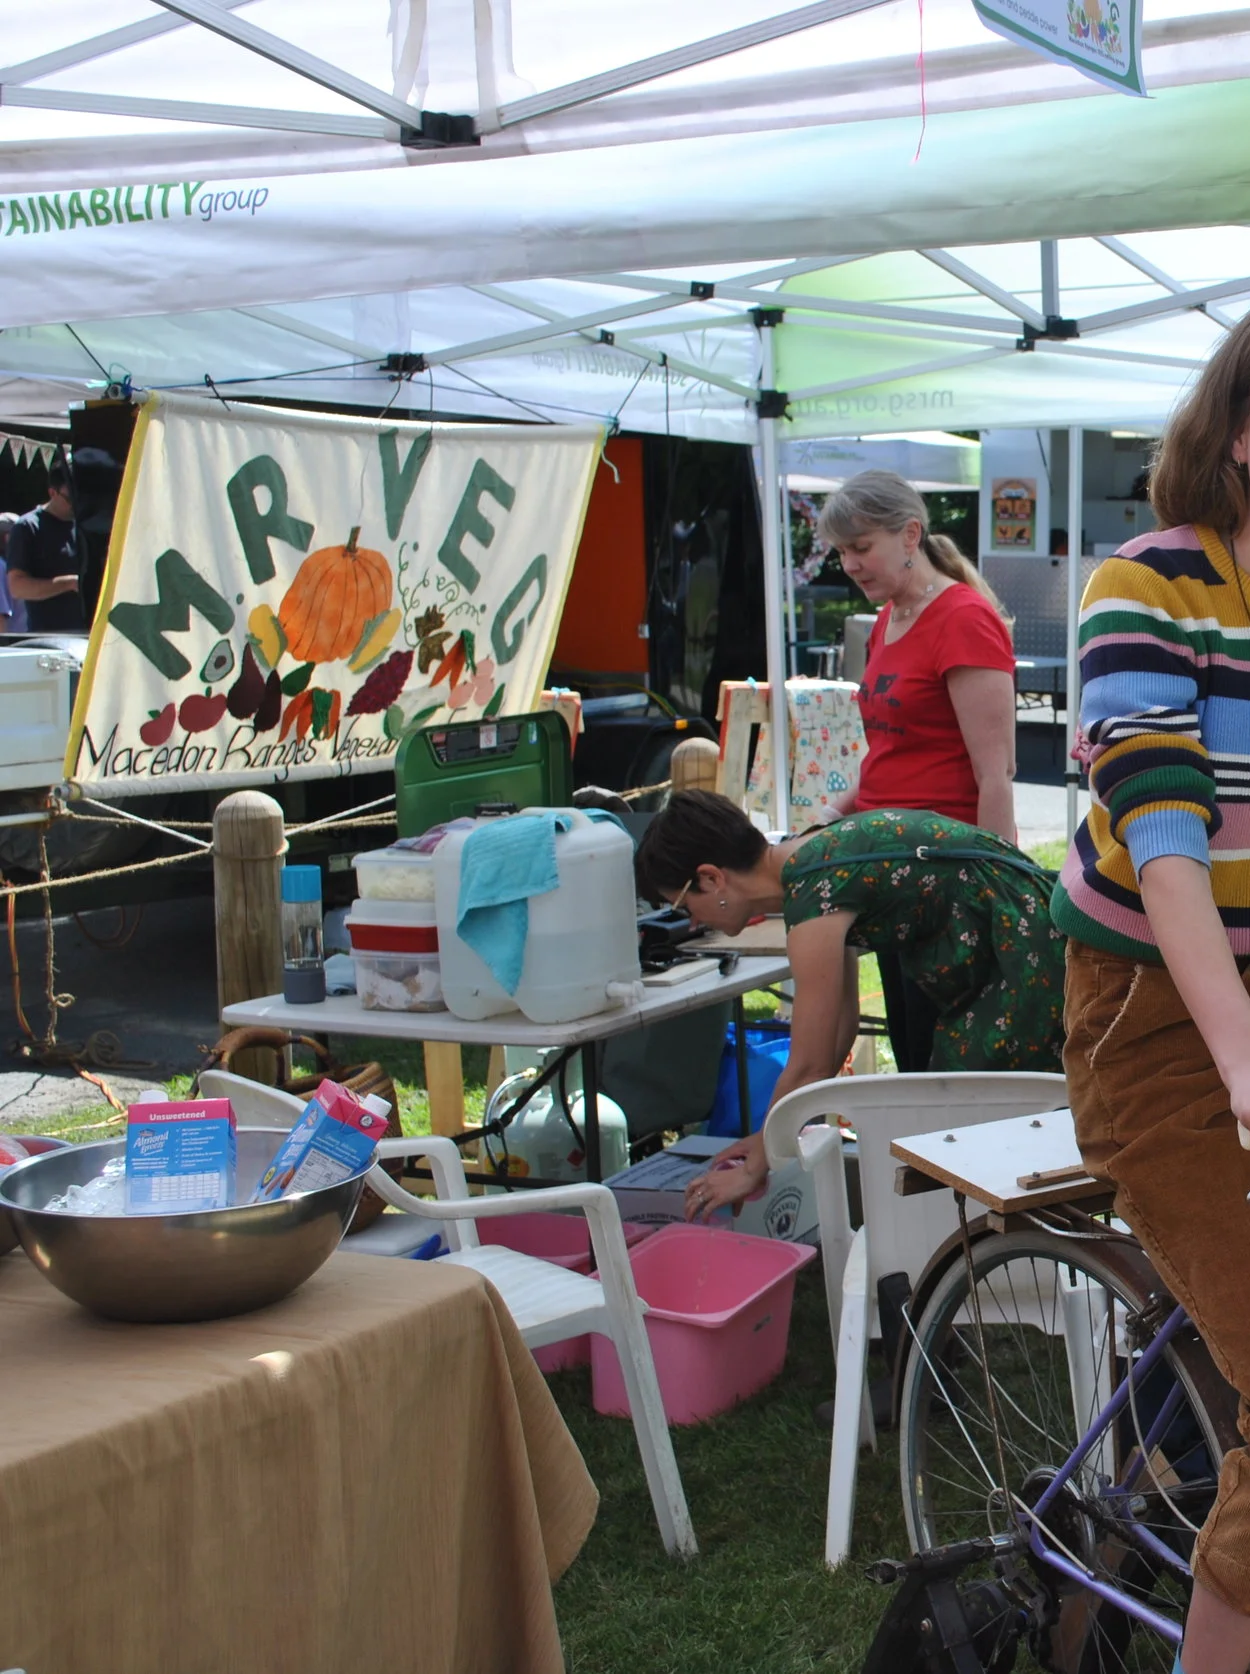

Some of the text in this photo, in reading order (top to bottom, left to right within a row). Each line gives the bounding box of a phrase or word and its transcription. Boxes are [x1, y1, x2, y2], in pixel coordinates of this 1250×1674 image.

[74, 723, 217, 777] Macedon
[220, 724, 318, 783] Ranges
[149, 1110, 206, 1121] Unsweetened
